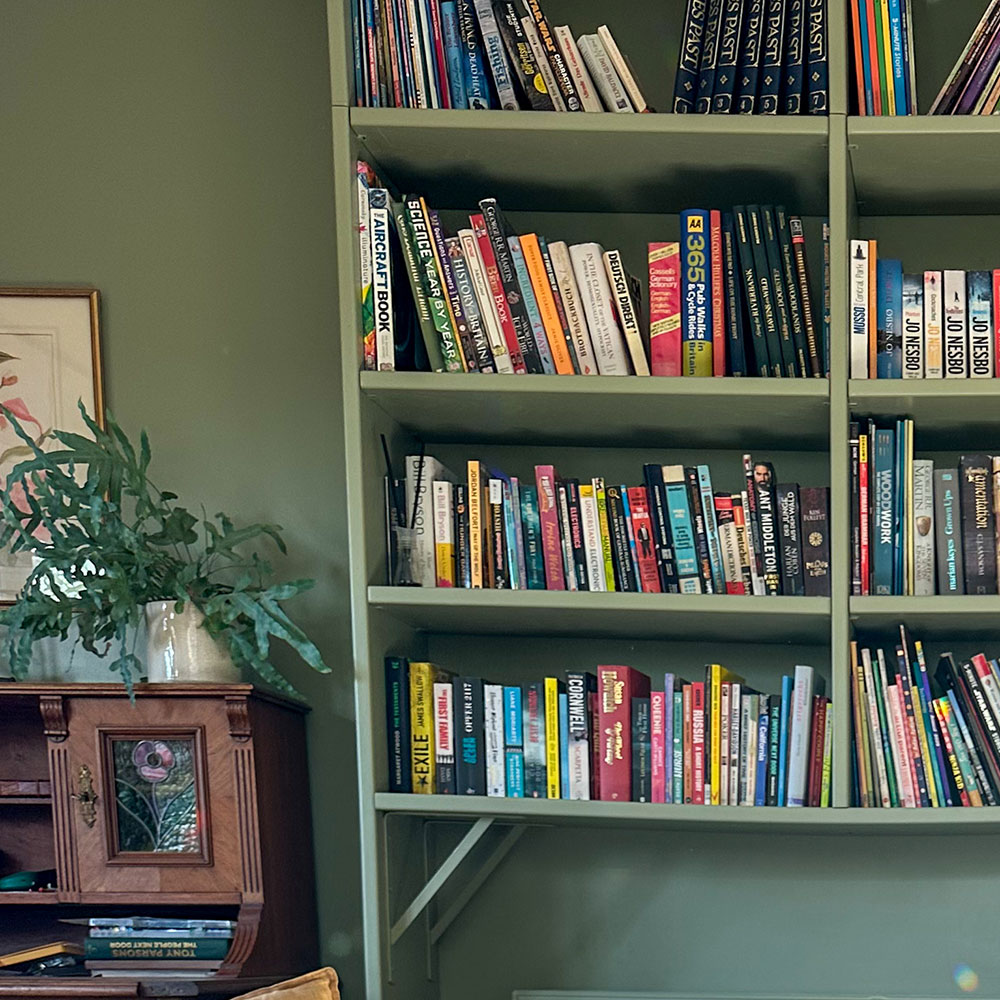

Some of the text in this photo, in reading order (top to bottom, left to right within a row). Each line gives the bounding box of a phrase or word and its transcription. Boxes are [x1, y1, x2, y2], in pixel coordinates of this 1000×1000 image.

[538, 21, 556, 52] WARS
[721, 15, 738, 60] PAST
[745, 17, 759, 61] PAST
[765, 16, 780, 60] PAST
[810, 10, 822, 55] PAST
[469, 52, 481, 97] DEAD HEAT
[554, 54, 574, 94] CHARACTER
[894, 53, 902, 78] Stories
[407, 200, 432, 258] SCIENCE
[690, 218, 701, 229] AA
[434, 227, 455, 290] Questions Answers
[686, 234, 706, 282] 365
[712, 226, 721, 263] MALCOLM
[373, 219, 390, 332] AIRCRAFT BOOK
[424, 258, 442, 297] YEAR
[500, 252, 513, 283] MARTIN
[608, 253, 625, 294] DEUTSCH
[433, 300, 448, 318] BY
[453, 258, 473, 308] HISTORY
[468, 314, 486, 359] BRITAIN
[494, 295, 508, 323] BOOK
[517, 262, 547, 355] INGREDIENT WAYS
[696, 283, 706, 340] Pub Walks
[745, 269, 758, 316] RIVERBANK
[760, 278, 774, 332] HAVENS WILD
[788, 283, 801, 333] WOODLANDS
[564, 288, 586, 358] BROTBACKBUCH
[591, 280, 604, 307] CLOSET
[603, 328, 615, 360] VATICAN
[686, 289, 696, 340] Cycle Rides
[714, 298, 722, 338] CHRISTMAS
[853, 307, 865, 335] MUSSO
[906, 318, 920, 332] JO
[928, 323, 940, 336] JO
[946, 316, 962, 332] JO
[973, 316, 988, 332] JO
[440, 322, 456, 358] YEAR
[688, 342, 696, 376] Britain
[787, 492, 795, 516] WALD
[880, 470, 892, 544] WOODWORK
[914, 465, 925, 511] MARTIN
[944, 490, 952, 507] Ups
[412, 485, 427, 536] Bryson
[437, 495, 447, 541] Bill Bryson
[471, 498, 479, 529] BELFORT
[584, 499, 595, 547] UNDERSTAND
[545, 521, 556, 551] Irvine
[736, 527, 746, 565] Deutsches
[759, 490, 777, 572] ANT MIDDLETON
[548, 554, 559, 582] Welsh
[416, 675, 424, 706] SWALLOW
[568, 679, 585, 733] CORNWELL
[438, 697, 449, 750] FIRST FAMILY
[652, 695, 662, 735] QUEENIE
[692, 710, 704, 744] RUSSIA
[414, 734, 429, 774] EXILE
[758, 726, 767, 761] California
[112, 949, 196, 958] TONY PARSONS
